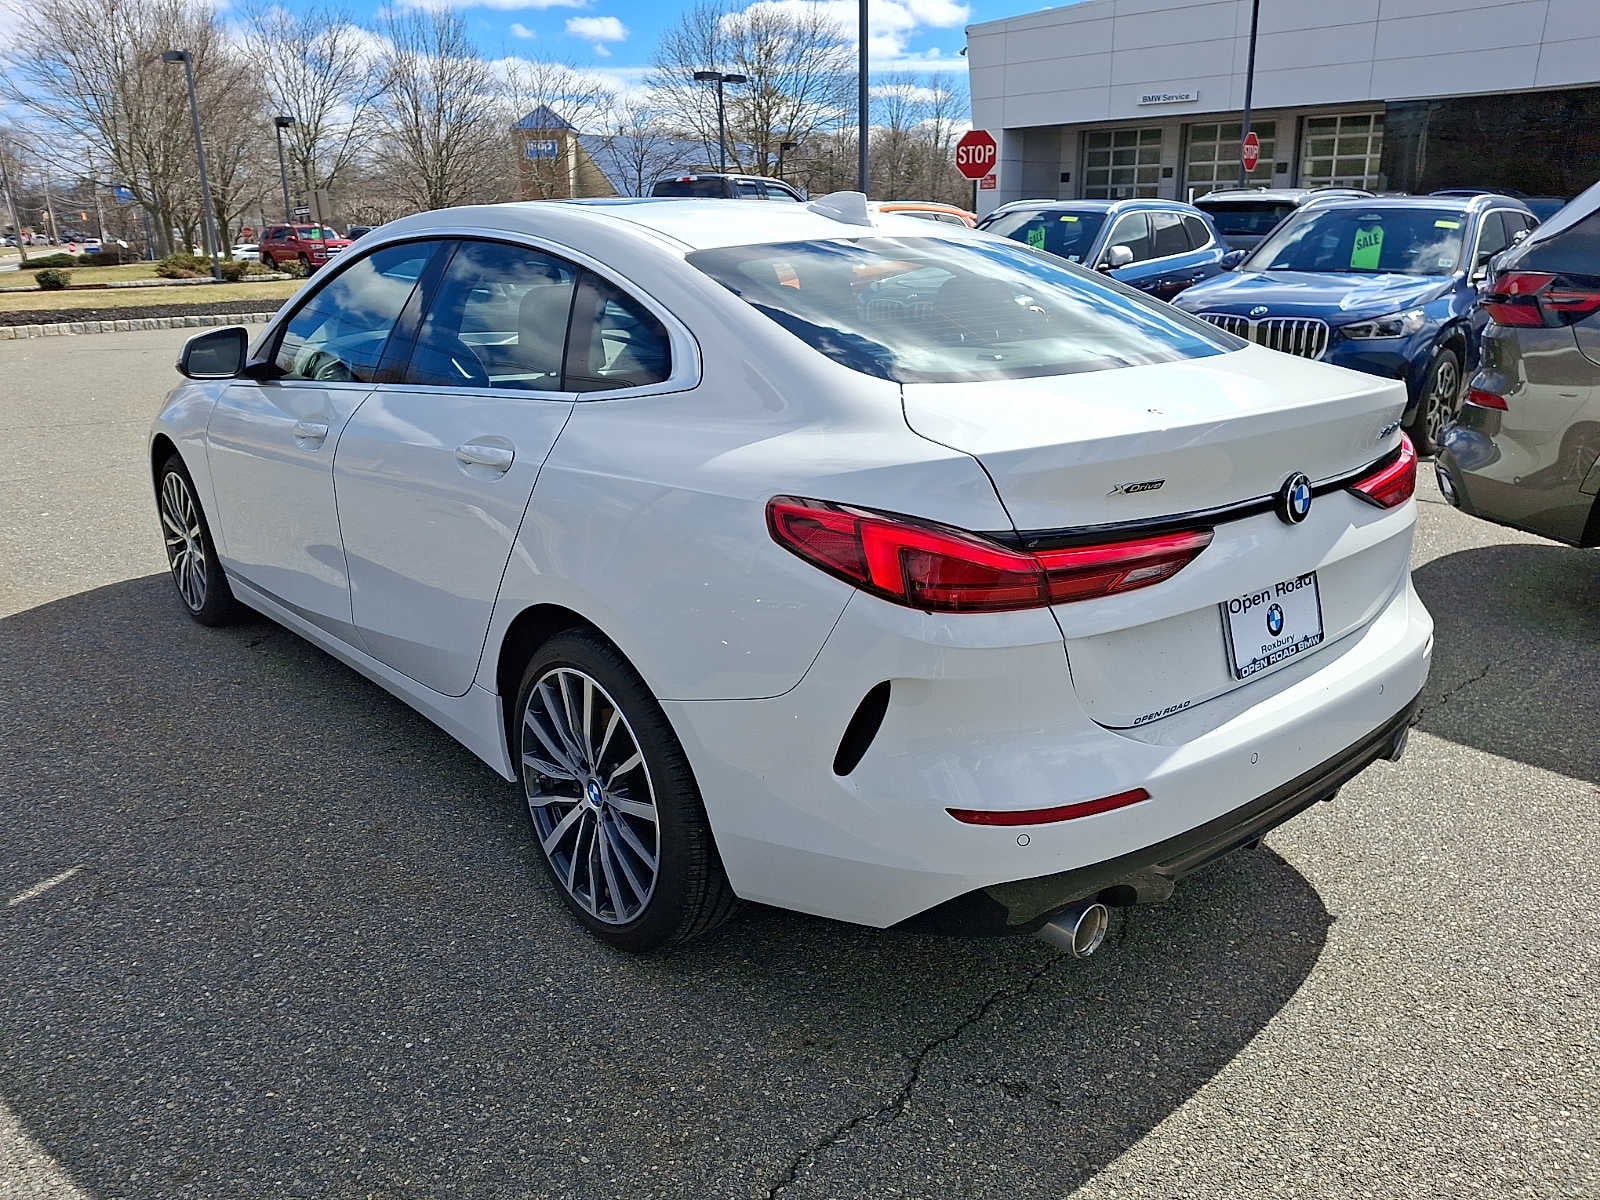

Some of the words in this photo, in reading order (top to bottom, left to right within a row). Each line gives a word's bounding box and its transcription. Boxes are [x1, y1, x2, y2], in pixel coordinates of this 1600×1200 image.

[1142, 95, 1161, 103] BMW
[1163, 94, 1190, 102] Service
[958, 145, 995, 164] STOP
[1244, 144, 1258, 160] STOP
[1356, 232, 1380, 251] SALE
[1229, 590, 1271, 614] Open
[1274, 576, 1312, 597] Road
[1261, 634, 1295, 654] Roxbury
[1241, 659, 1268, 678] OPEN
[1269, 644, 1297, 664] ROAD
[1298, 635, 1320, 651] BMW
[1133, 710, 1162, 725] OPEN
[1163, 700, 1191, 715] ROAD
